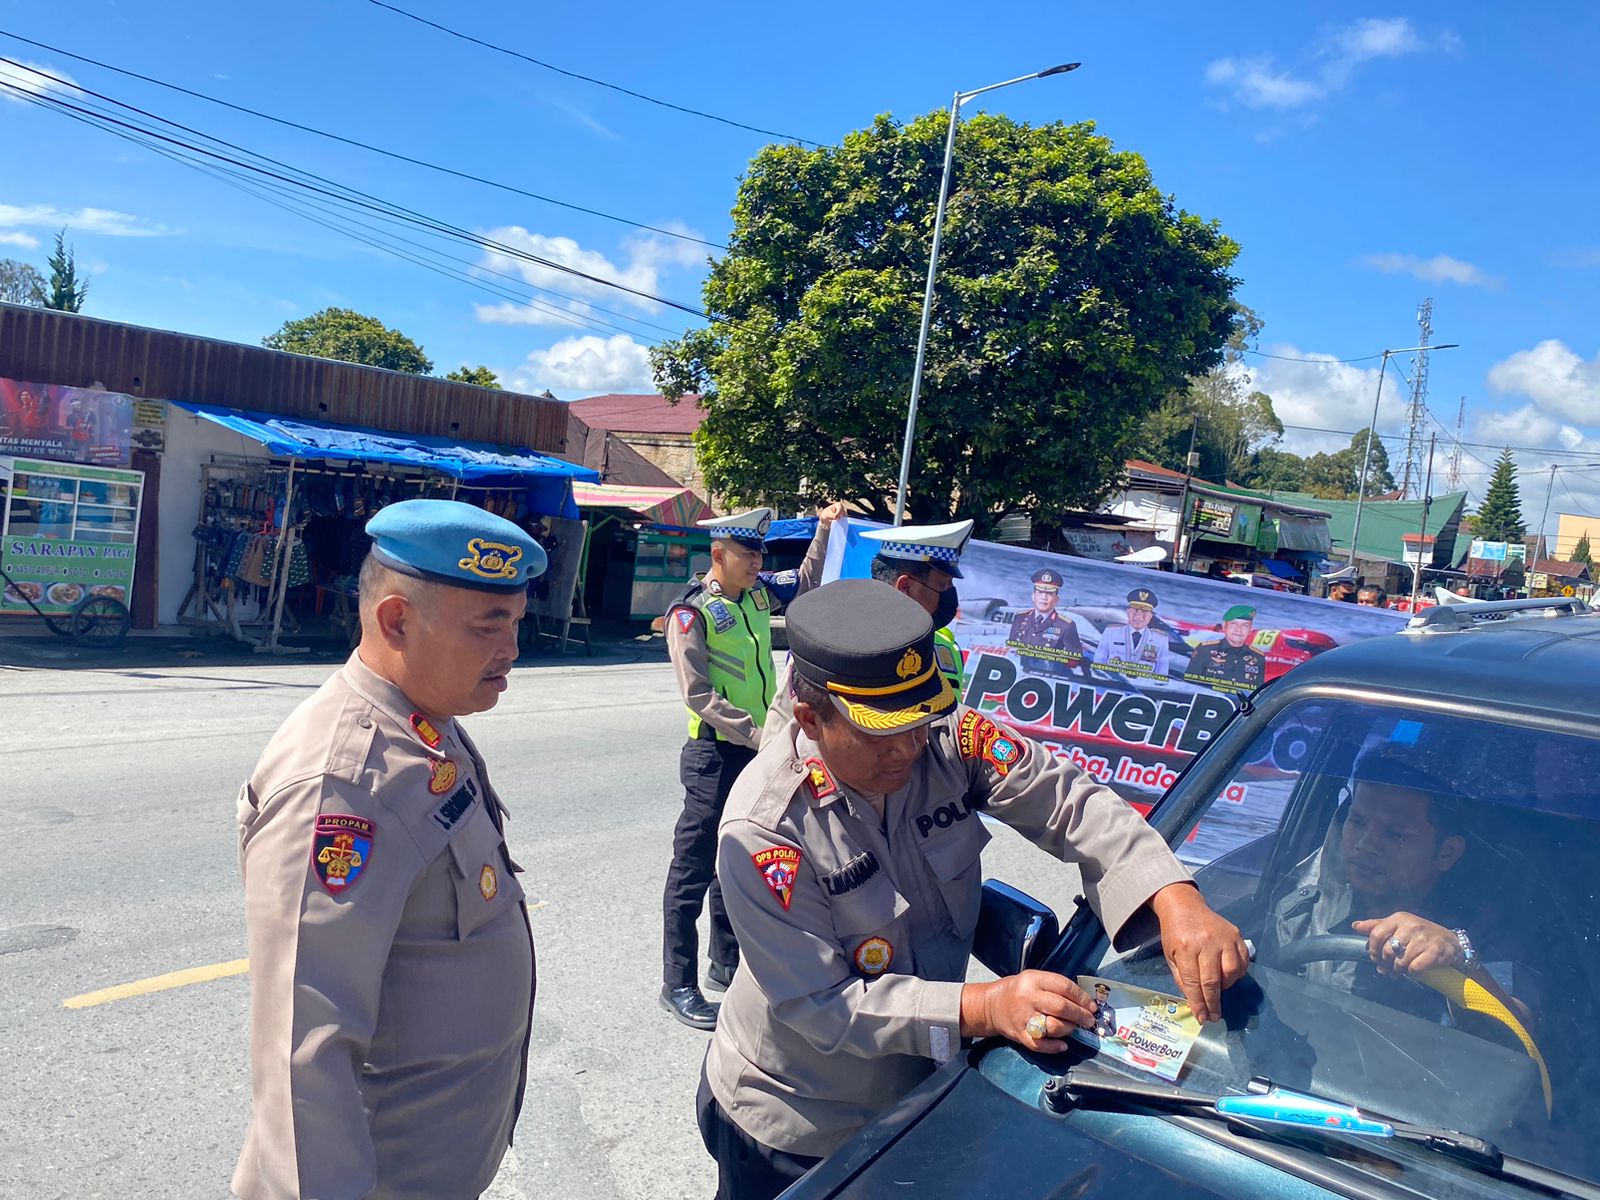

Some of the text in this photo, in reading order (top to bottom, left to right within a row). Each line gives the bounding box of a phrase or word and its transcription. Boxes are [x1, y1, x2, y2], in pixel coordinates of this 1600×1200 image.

[21, 438, 63, 448] MENYALA
[10, 541, 132, 559] SARAPAN PAGI
[1256, 631, 1277, 646] 15
[1090, 663, 1121, 673] GUBERNUR
[960, 712, 976, 755] POLRES
[324, 818, 369, 831] PROPAM
[756, 849, 797, 863] OPS POLRI
